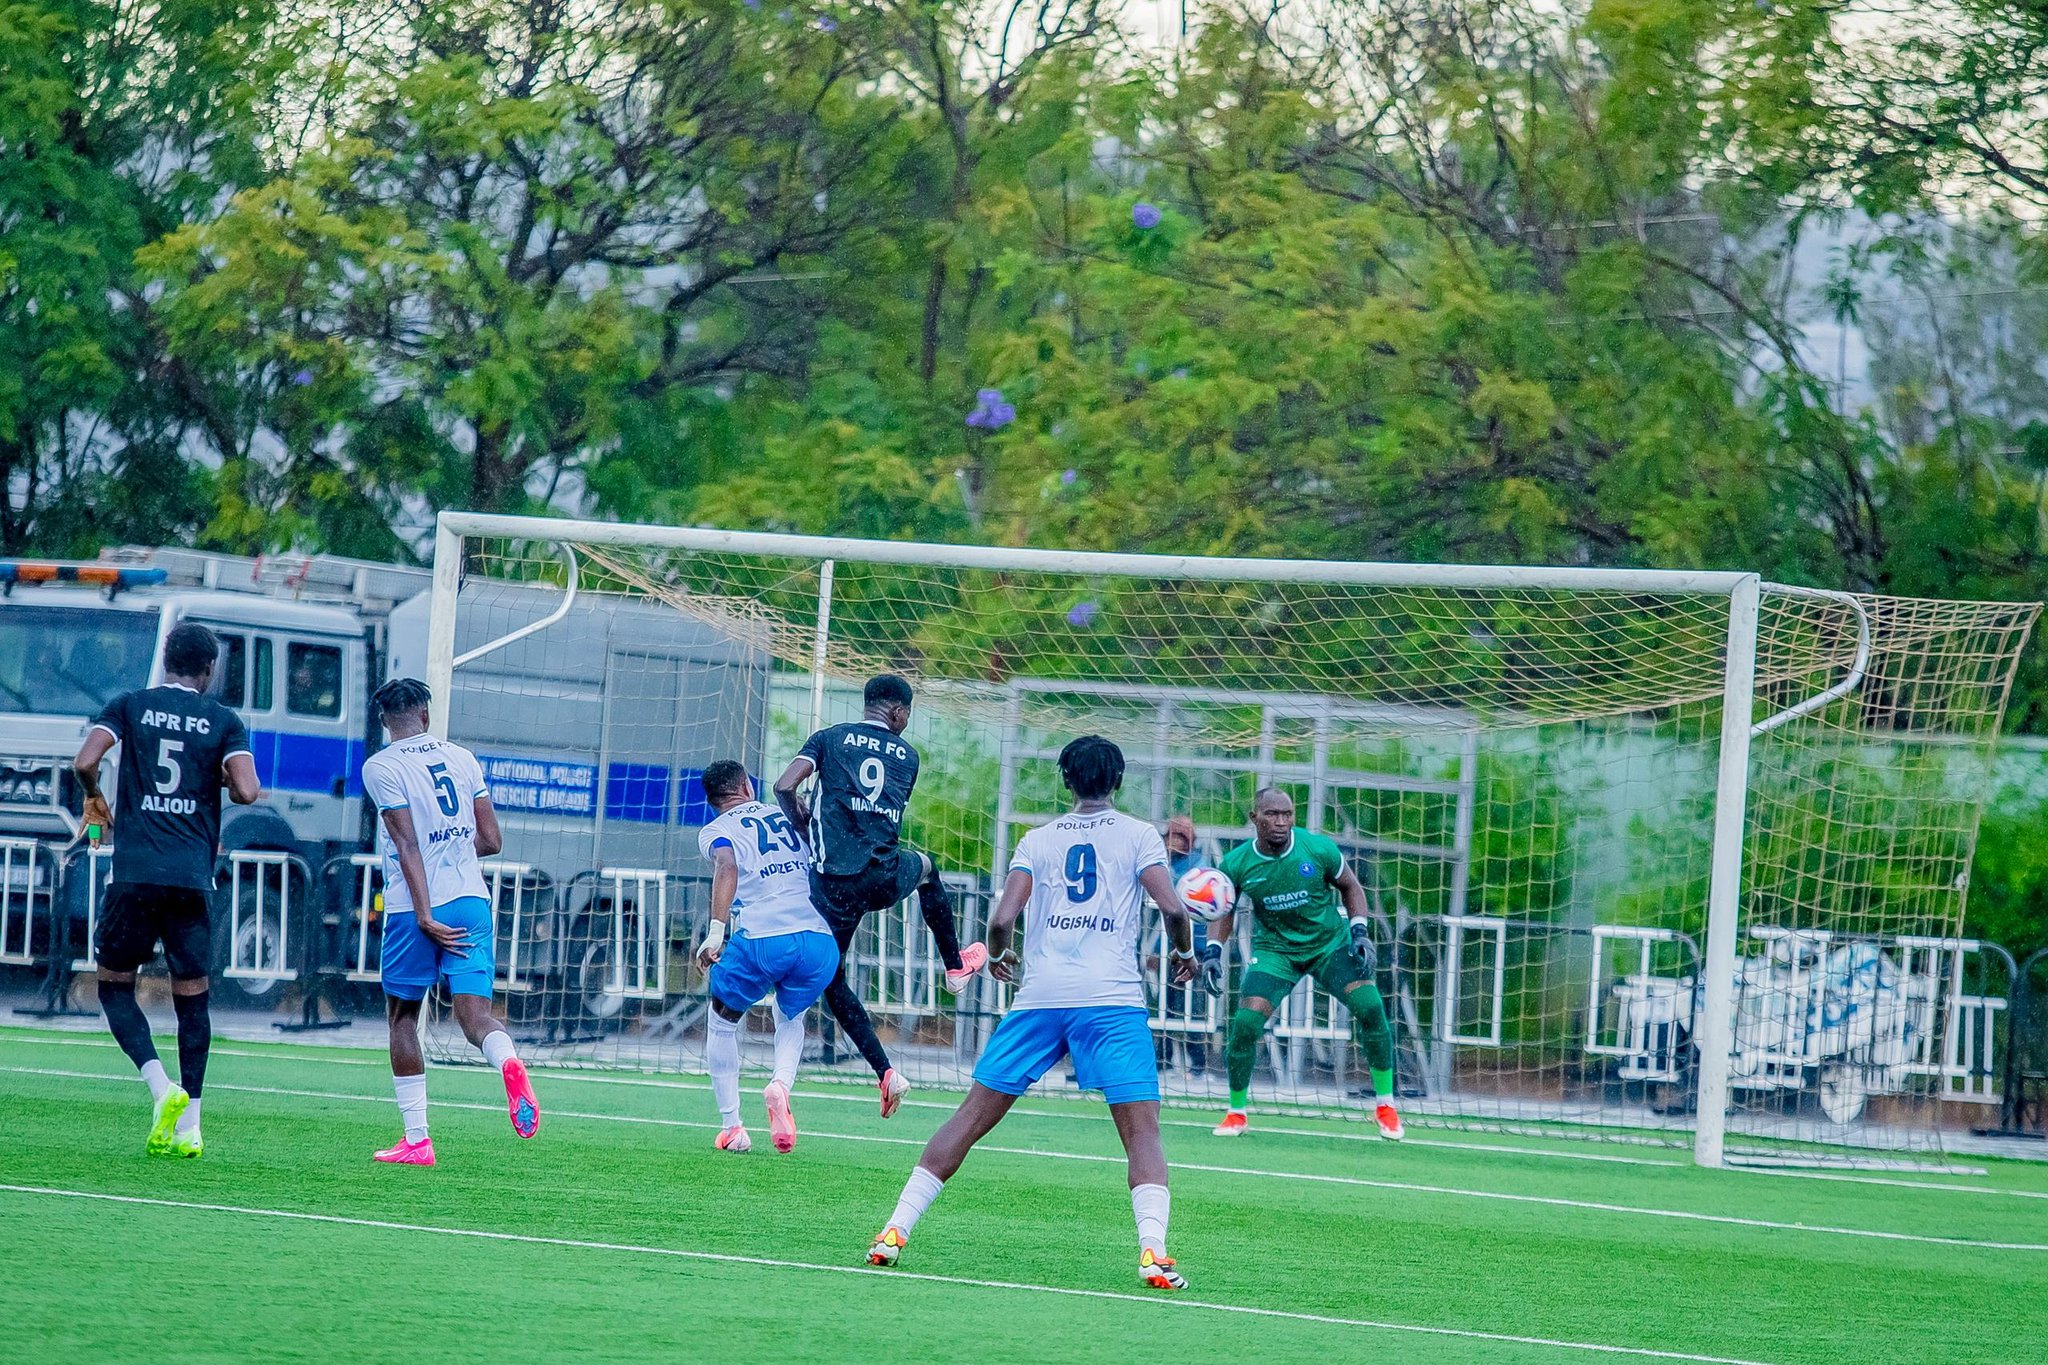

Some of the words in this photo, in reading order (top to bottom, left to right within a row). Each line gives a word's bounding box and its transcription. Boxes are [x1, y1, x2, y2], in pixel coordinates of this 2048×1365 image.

[141, 709, 181, 731] APR
[185, 716, 210, 734] FC
[843, 733, 880, 751] APR
[885, 742, 907, 760] FC
[155, 738, 184, 794] 5
[859, 757, 885, 803] 9
[141, 795, 196, 815] ALIOU
[425, 762, 459, 817] 5
[740, 812, 802, 856] 25
[1099, 817, 1115, 826] FC
[1064, 843, 1098, 904] 9
[1263, 890, 1308, 904] GERAYO
